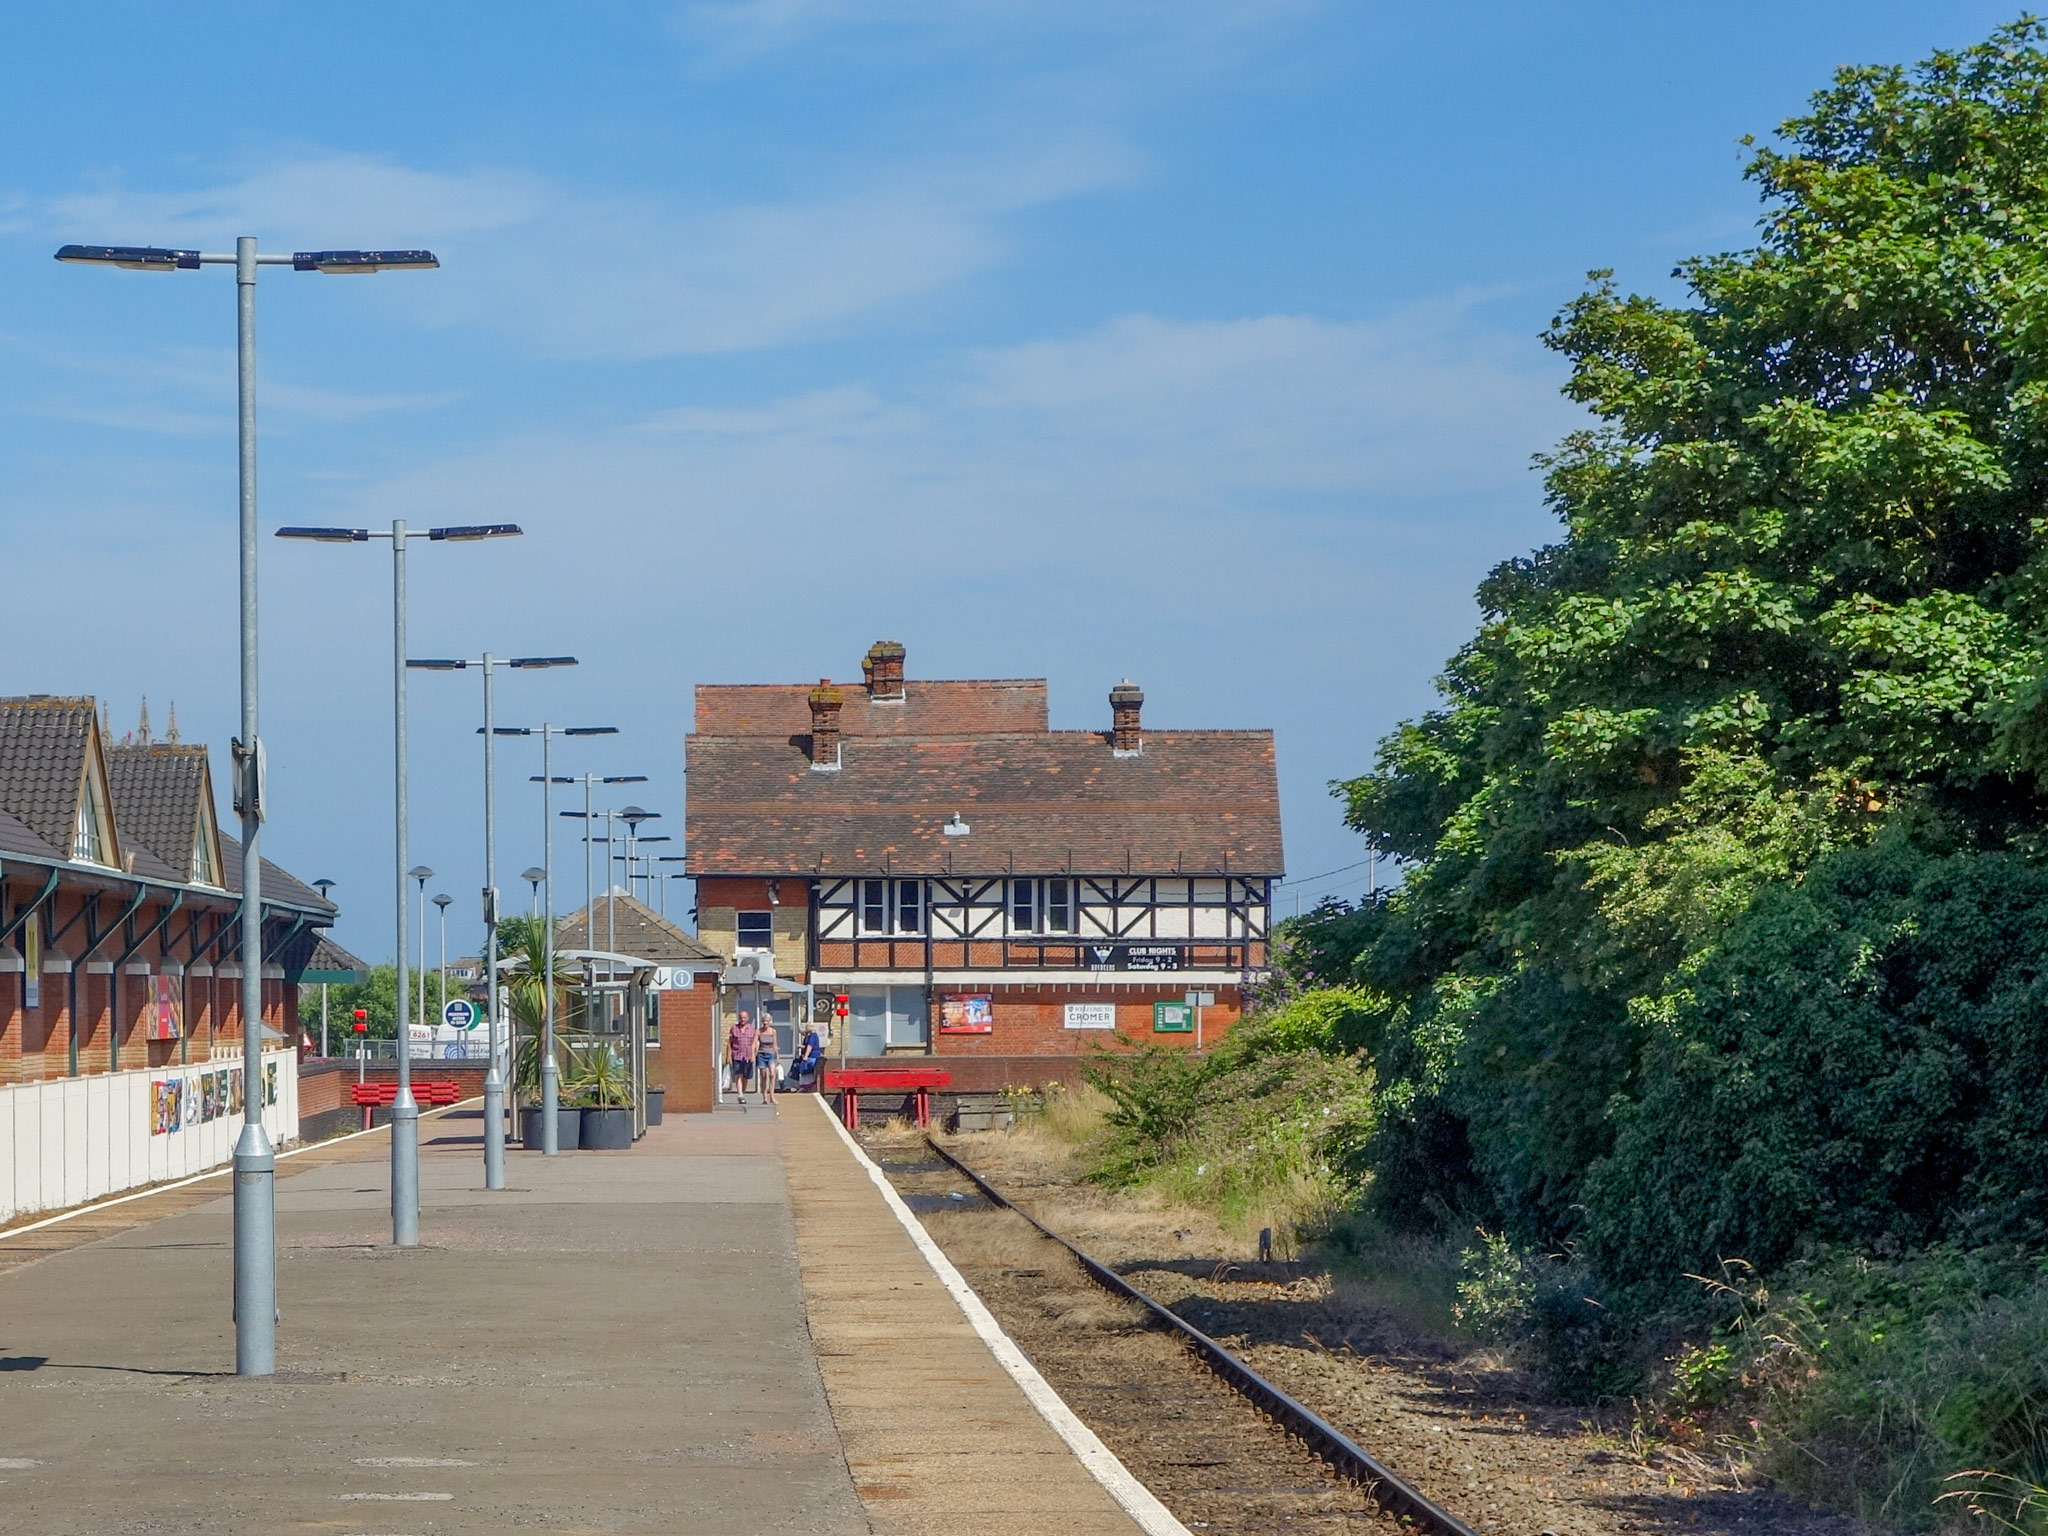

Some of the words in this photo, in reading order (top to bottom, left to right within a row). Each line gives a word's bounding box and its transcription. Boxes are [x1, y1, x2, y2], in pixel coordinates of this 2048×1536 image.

[1128, 947, 1147, 955] CLUB
[1149, 947, 1176, 955] NIGHTS
[1132, 956, 1153, 964] Friday
[1127, 963, 1159, 971] Saturday
[1069, 1013, 1110, 1021] CROMER
